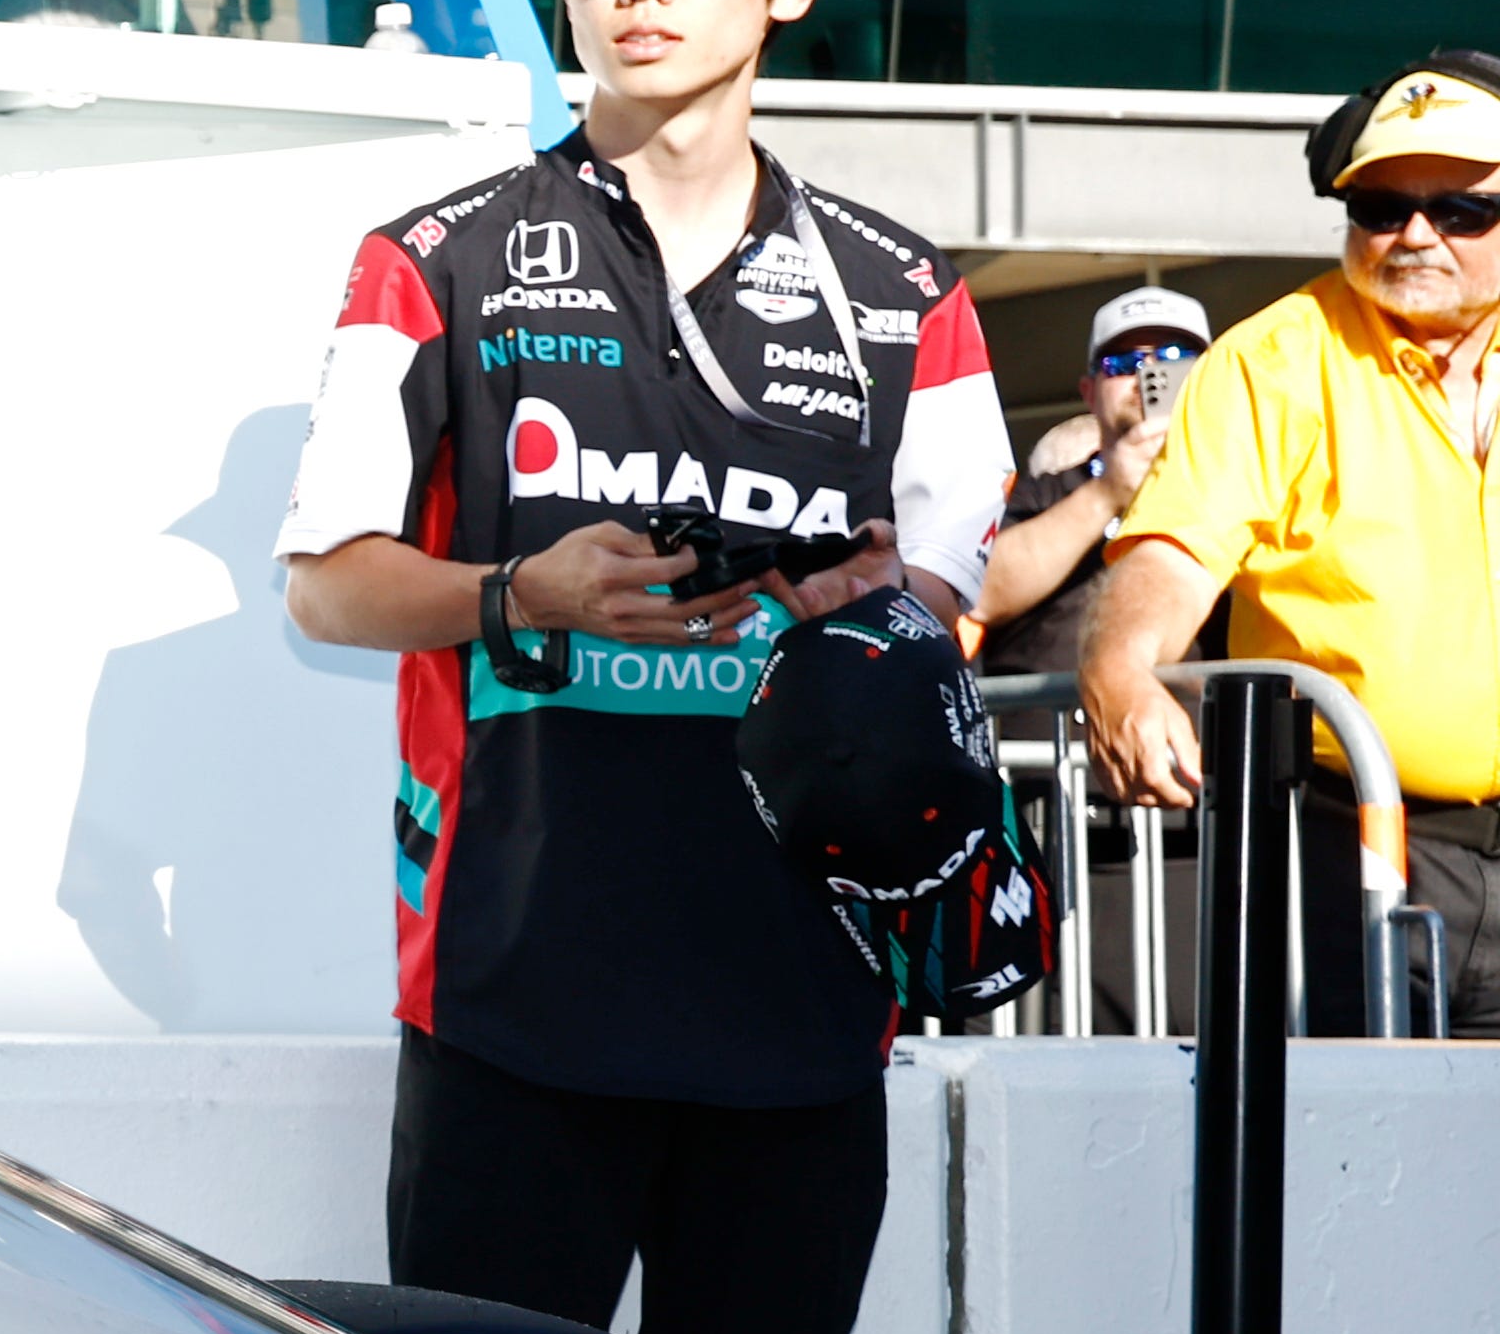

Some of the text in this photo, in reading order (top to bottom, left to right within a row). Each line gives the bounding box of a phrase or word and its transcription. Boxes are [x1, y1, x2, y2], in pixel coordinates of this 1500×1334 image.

[403, 215, 447, 258] 75
[481, 285, 617, 317] HONDA
[478, 326, 623, 373] Niterra
[507, 397, 852, 540] AMADA
